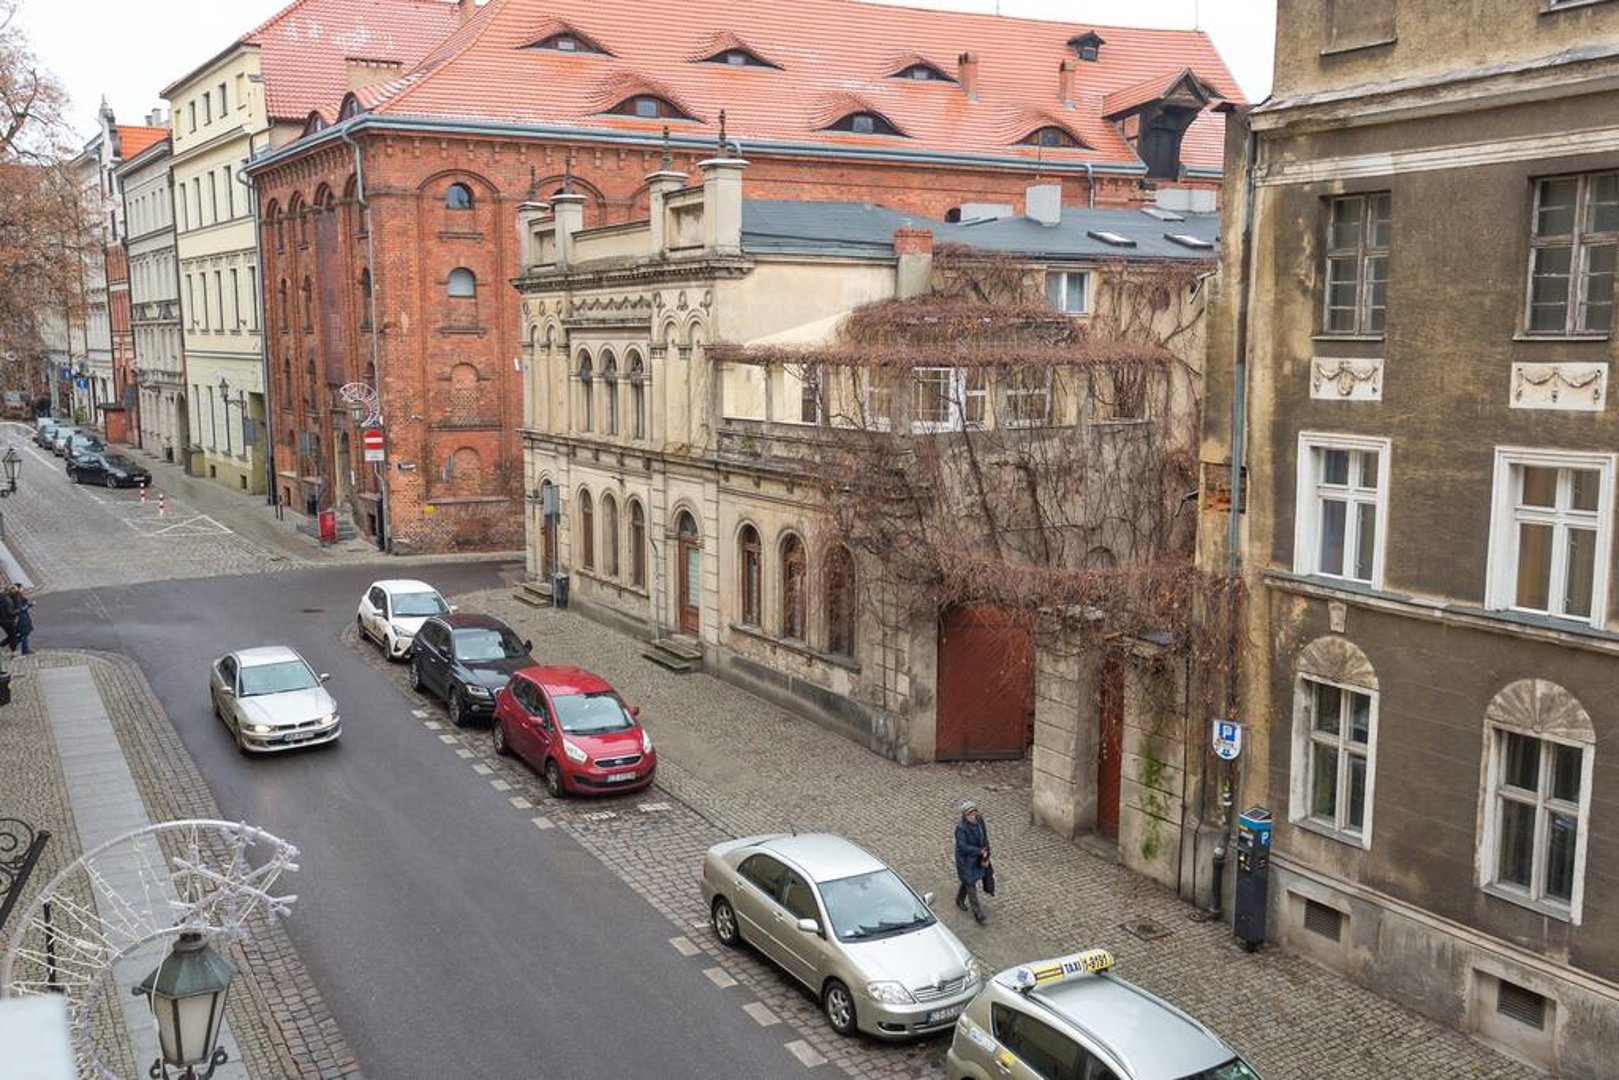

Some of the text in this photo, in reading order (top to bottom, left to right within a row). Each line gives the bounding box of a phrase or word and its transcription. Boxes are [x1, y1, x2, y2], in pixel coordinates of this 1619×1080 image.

[1223, 725, 1232, 739] P
[1261, 831, 1269, 845] P
[1064, 961, 1082, 974] TAXI
